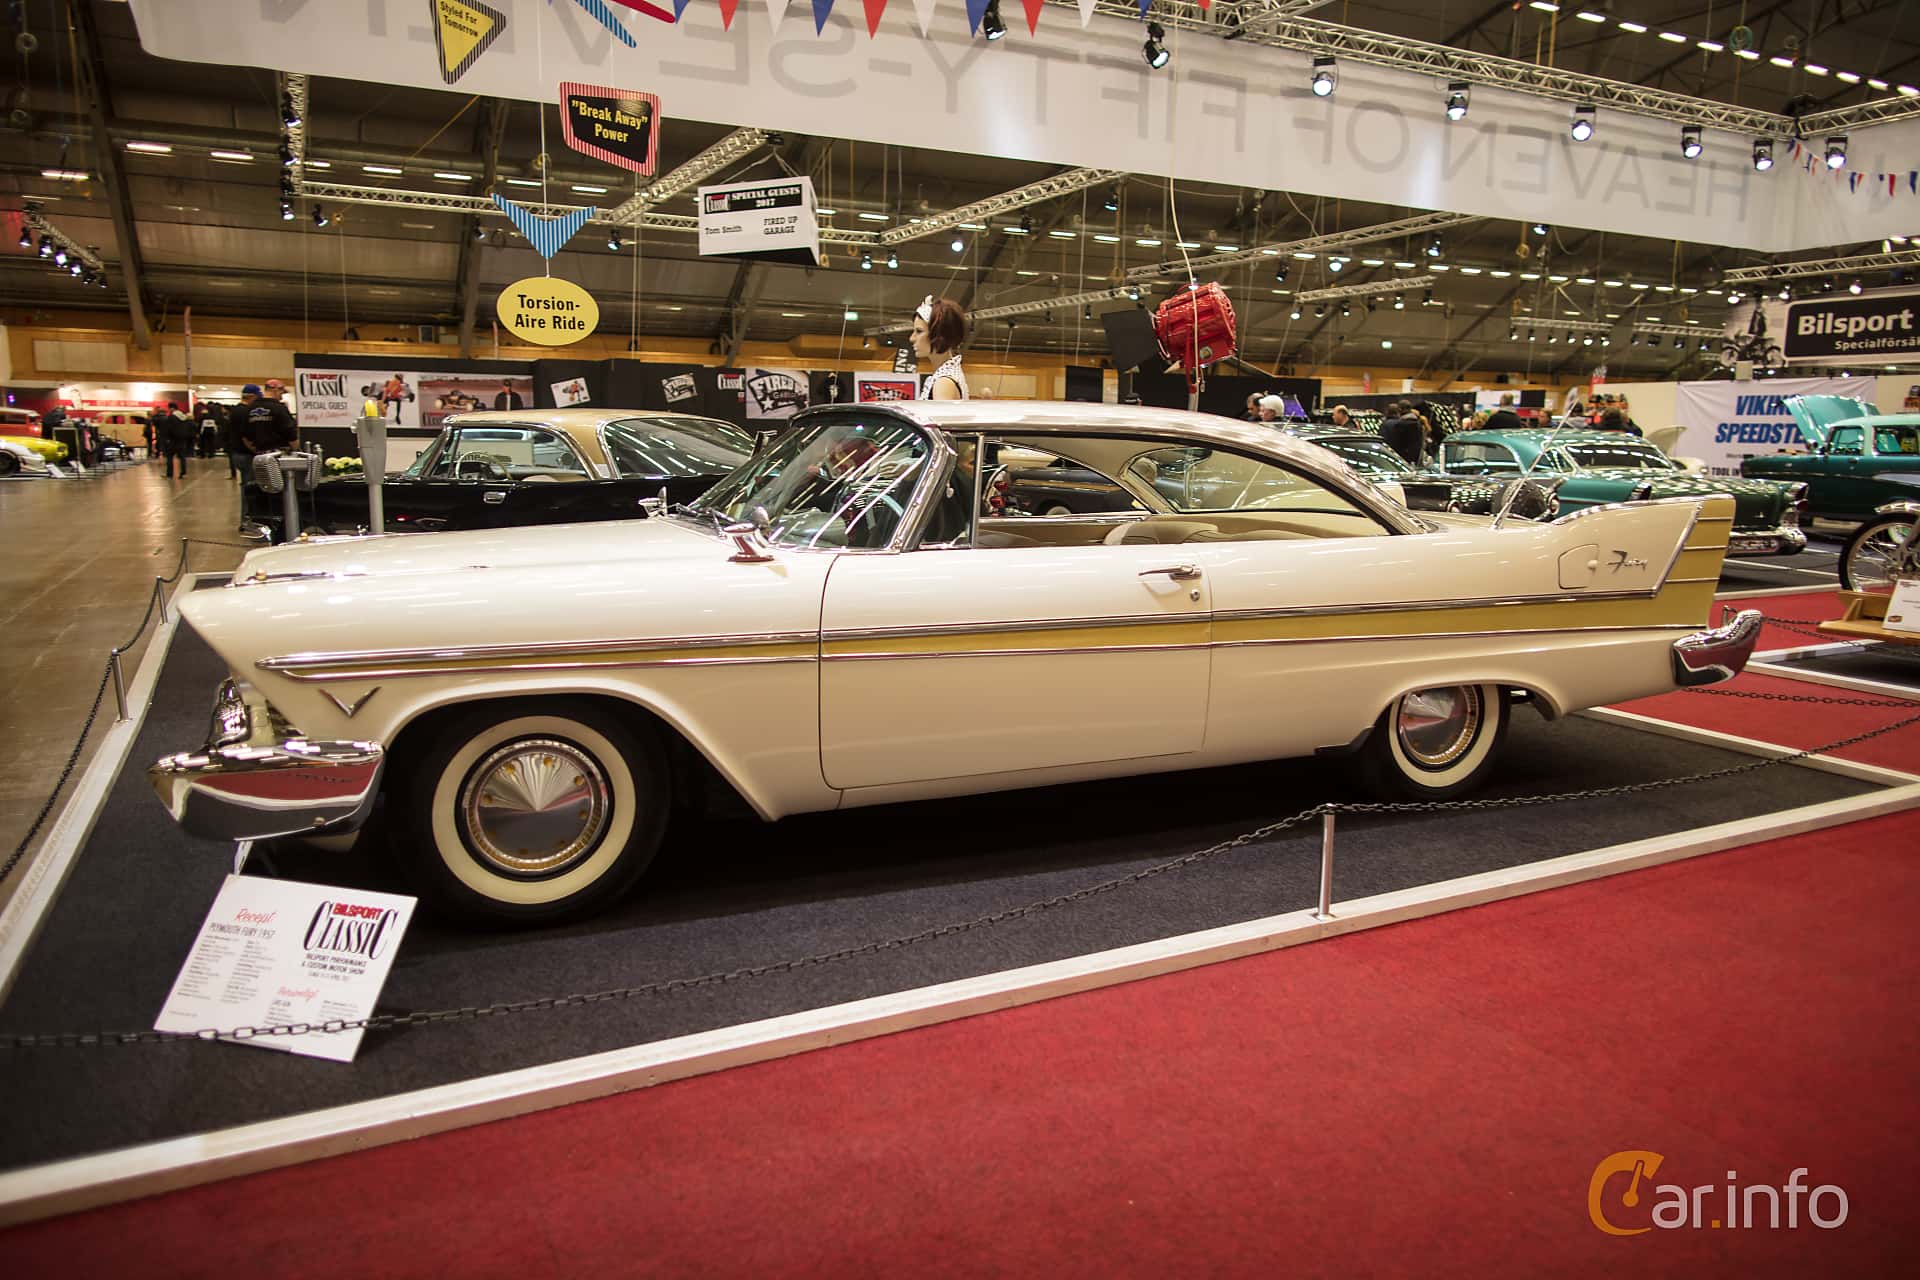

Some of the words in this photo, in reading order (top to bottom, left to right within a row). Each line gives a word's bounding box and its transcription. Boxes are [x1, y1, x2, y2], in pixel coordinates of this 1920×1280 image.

[440, 0, 463, 19] Styled
[465, 12, 477, 24] For
[443, 14, 478, 37] Tomorrow
[594, 123, 629, 143] Power
[732, 190, 767, 200] SPECIAL
[768, 187, 801, 197] GUESTS
[763, 217, 785, 226] FIRED
[787, 215, 798, 224] UP
[763, 225, 796, 235] GARAGE
[704, 227, 720, 236] Tom
[722, 225, 742, 234] Smith
[517, 294, 580, 311] Torsion-
[515, 314, 546, 329] Aire
[552, 315, 585, 330] Ride
[1798, 309, 1914, 338] Bilsport
[300, 373, 348, 398] CLASSIC
[302, 401, 326, 410] SPECIAL
[328, 401, 348, 410] GUEST
[1608, 549, 1648, 574] Fury
[333, 902, 384, 921] BILSPORT
[303, 900, 399, 960] CLASSIC
